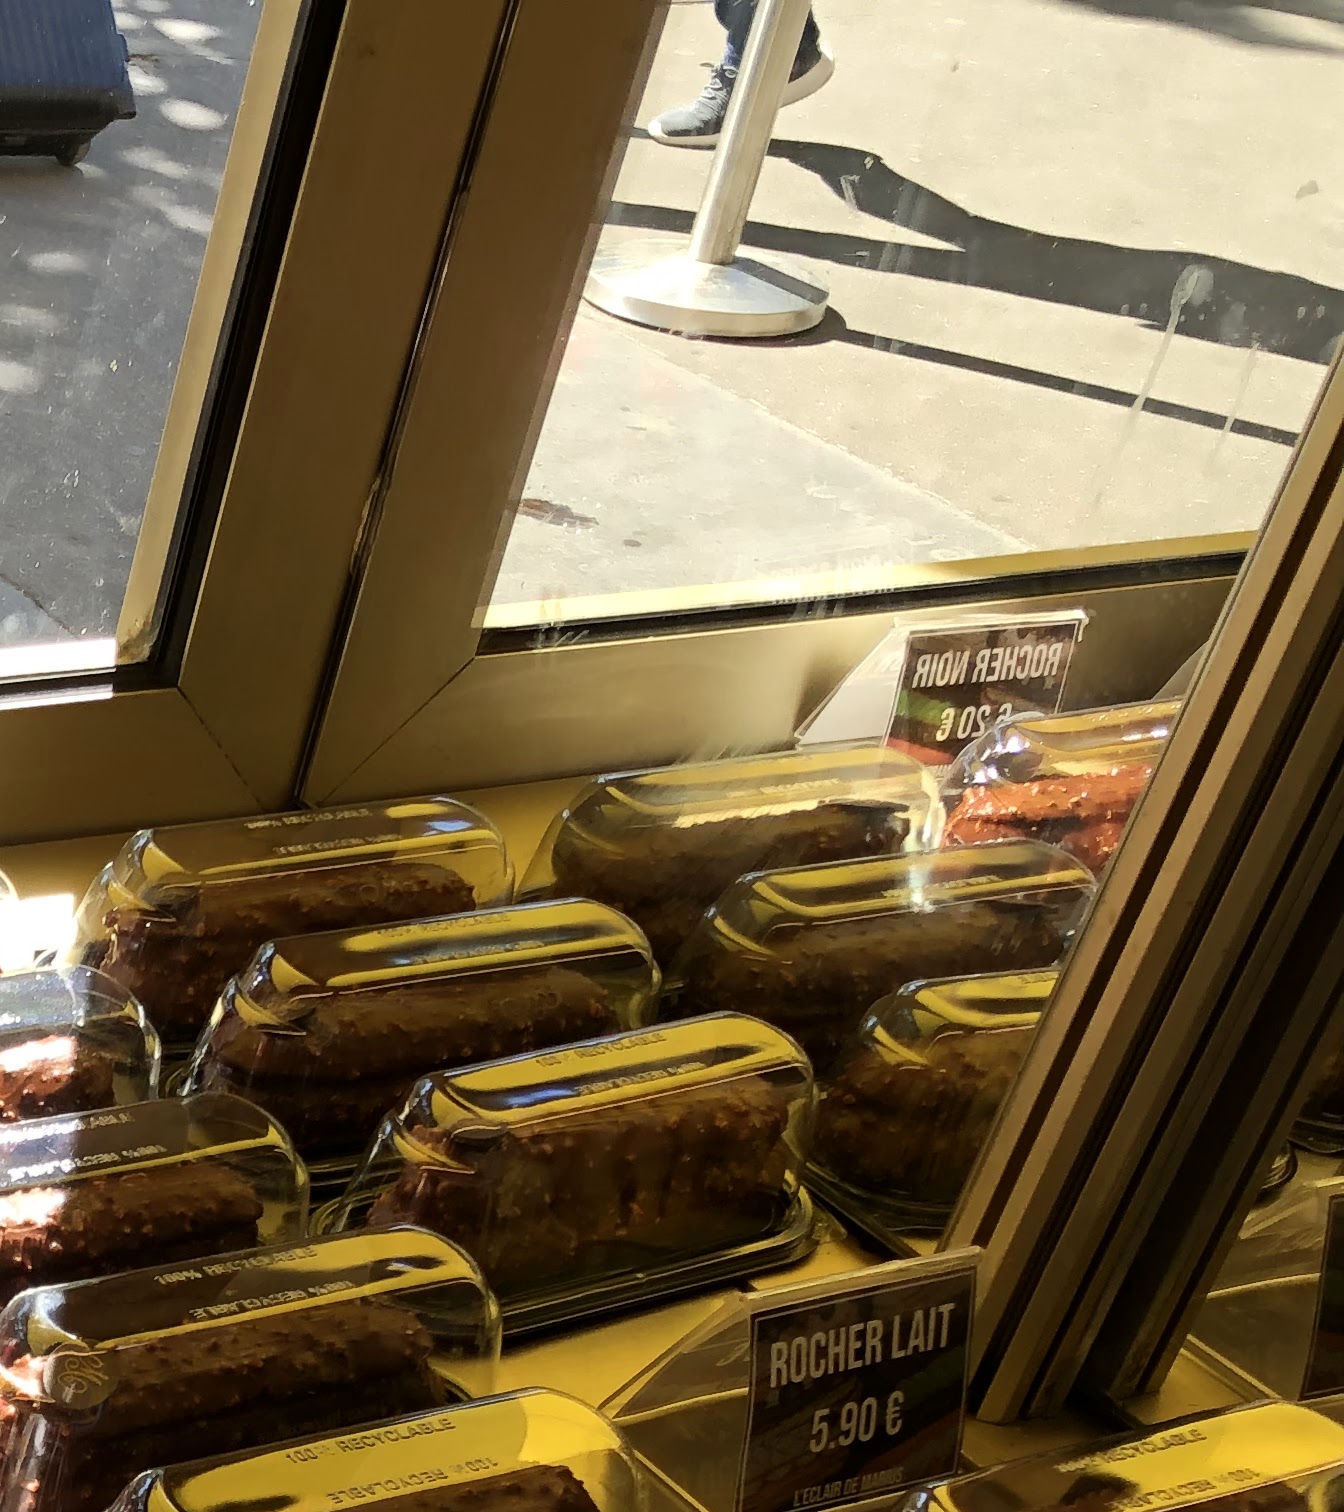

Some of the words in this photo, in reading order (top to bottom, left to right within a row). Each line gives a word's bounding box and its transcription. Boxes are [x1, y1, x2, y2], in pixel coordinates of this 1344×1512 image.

[769, 1319, 884, 1389] ROCHER
[891, 1303, 956, 1360] LAIT
[336, 1416, 456, 1453] RECYCLABLE
[809, 1396, 877, 1453] 5.90
[885, 1390, 905, 1436] €
[326, 1468, 448, 1504] RECYCLABLE
